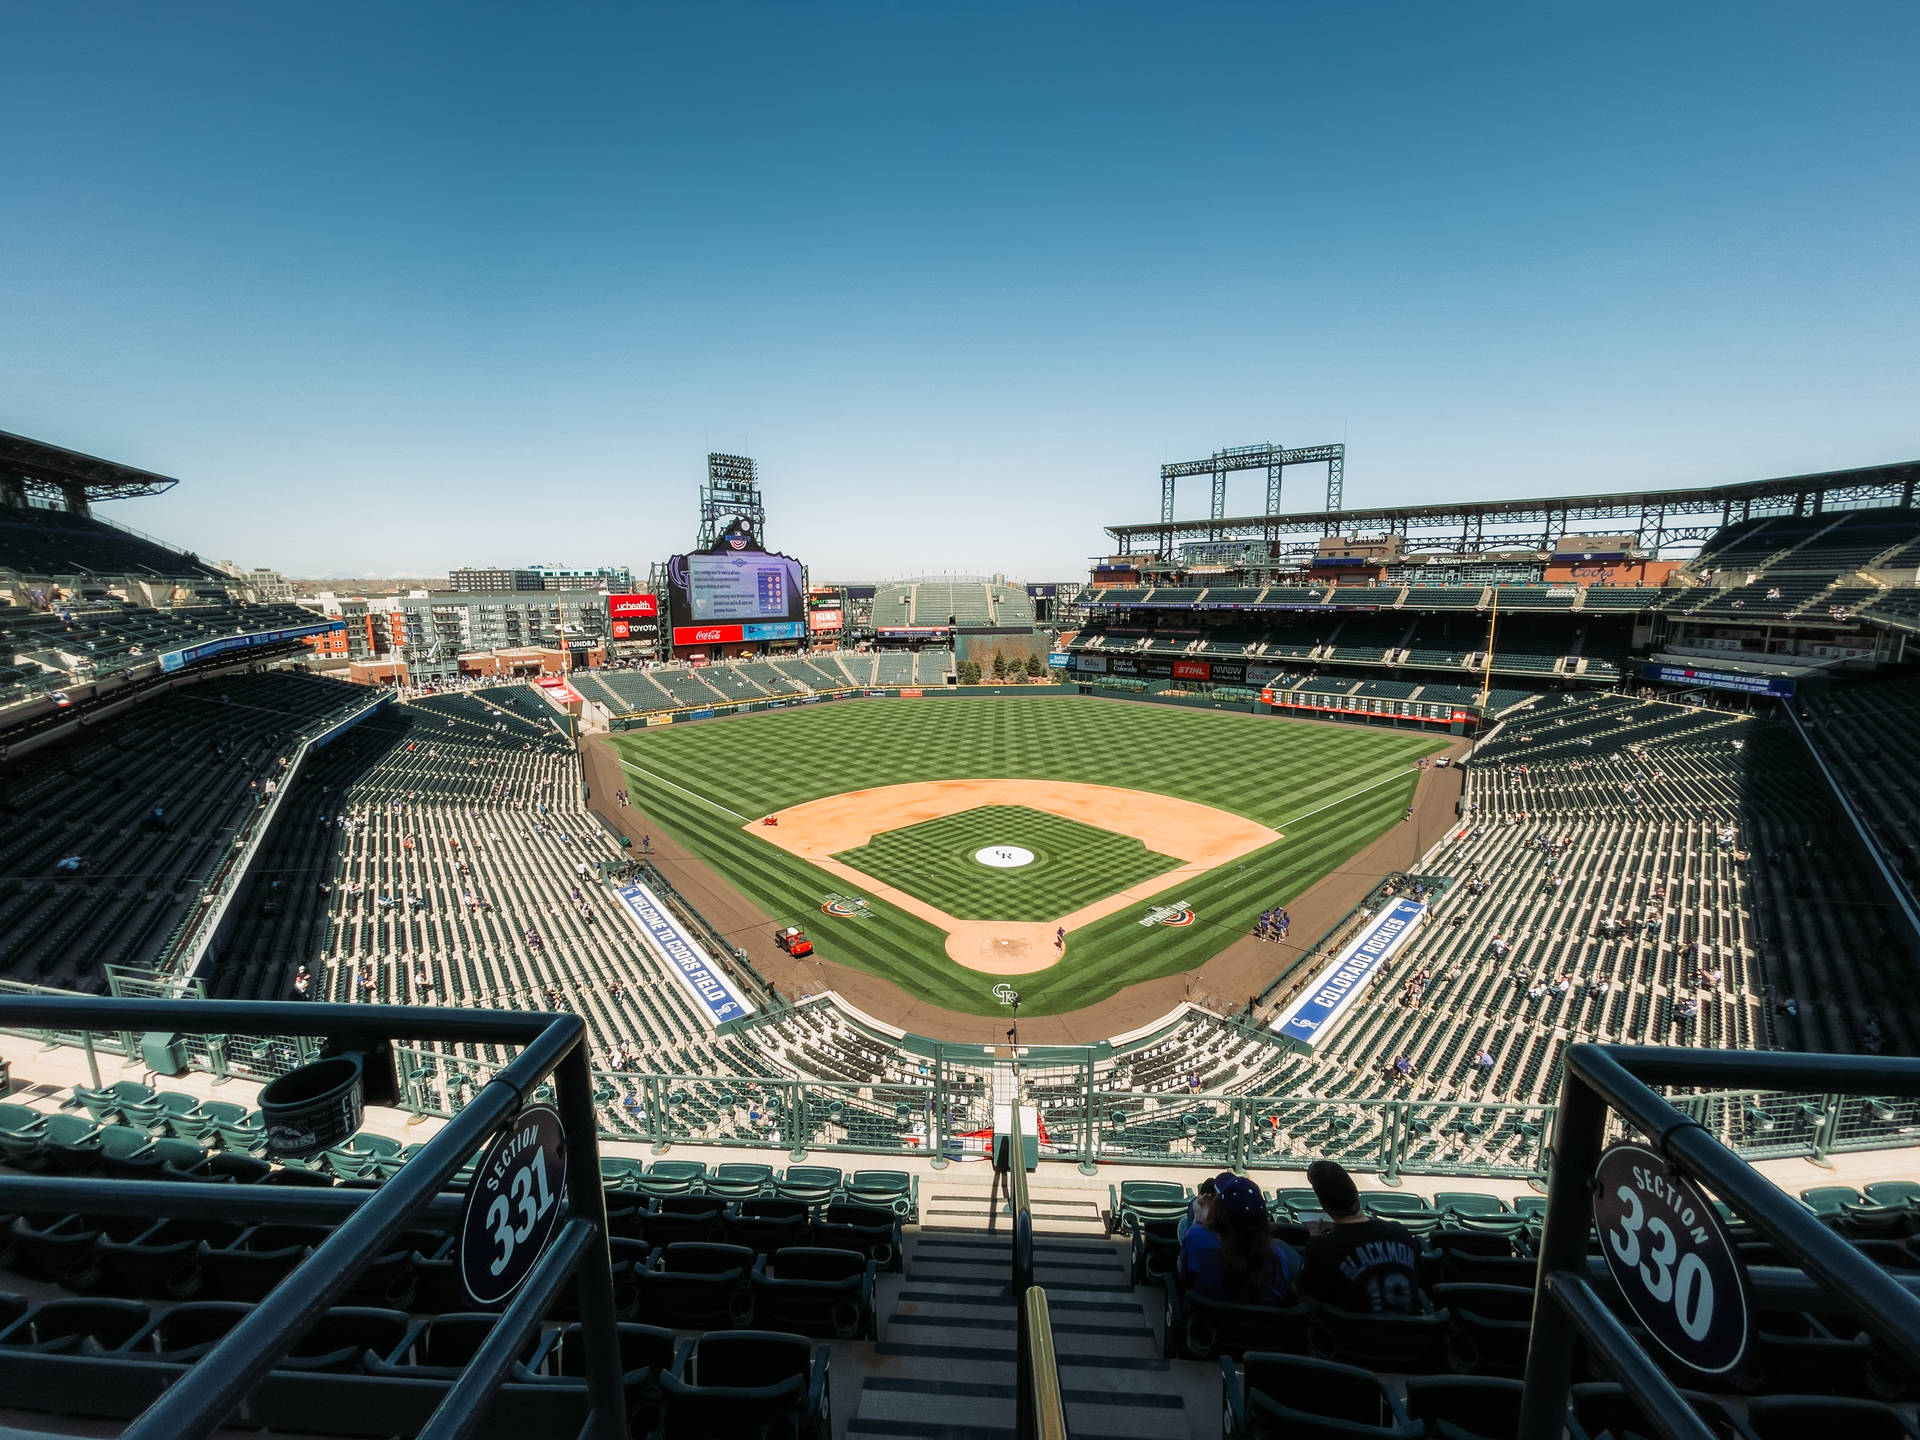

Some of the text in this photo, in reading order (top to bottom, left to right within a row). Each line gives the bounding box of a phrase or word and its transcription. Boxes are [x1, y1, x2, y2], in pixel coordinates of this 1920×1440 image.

[1571, 567, 1614, 578] Coors
[617, 600, 651, 609] uchealth
[568, 640, 597, 648] TUNDRA
[1178, 666, 1205, 675] STIHL
[629, 894, 668, 931] WELCOME
[657, 930, 676, 942] TO
[665, 940, 701, 971] COORS
[1314, 953, 1374, 1008] COLORADO
[1367, 917, 1406, 955] ROCKIES
[690, 969, 727, 1002] FIELD
[486, 1124, 539, 1191] SECTION
[486, 1144, 554, 1277] 331
[1632, 1165, 1709, 1245] SECTION
[1609, 1185, 1714, 1342] 330
